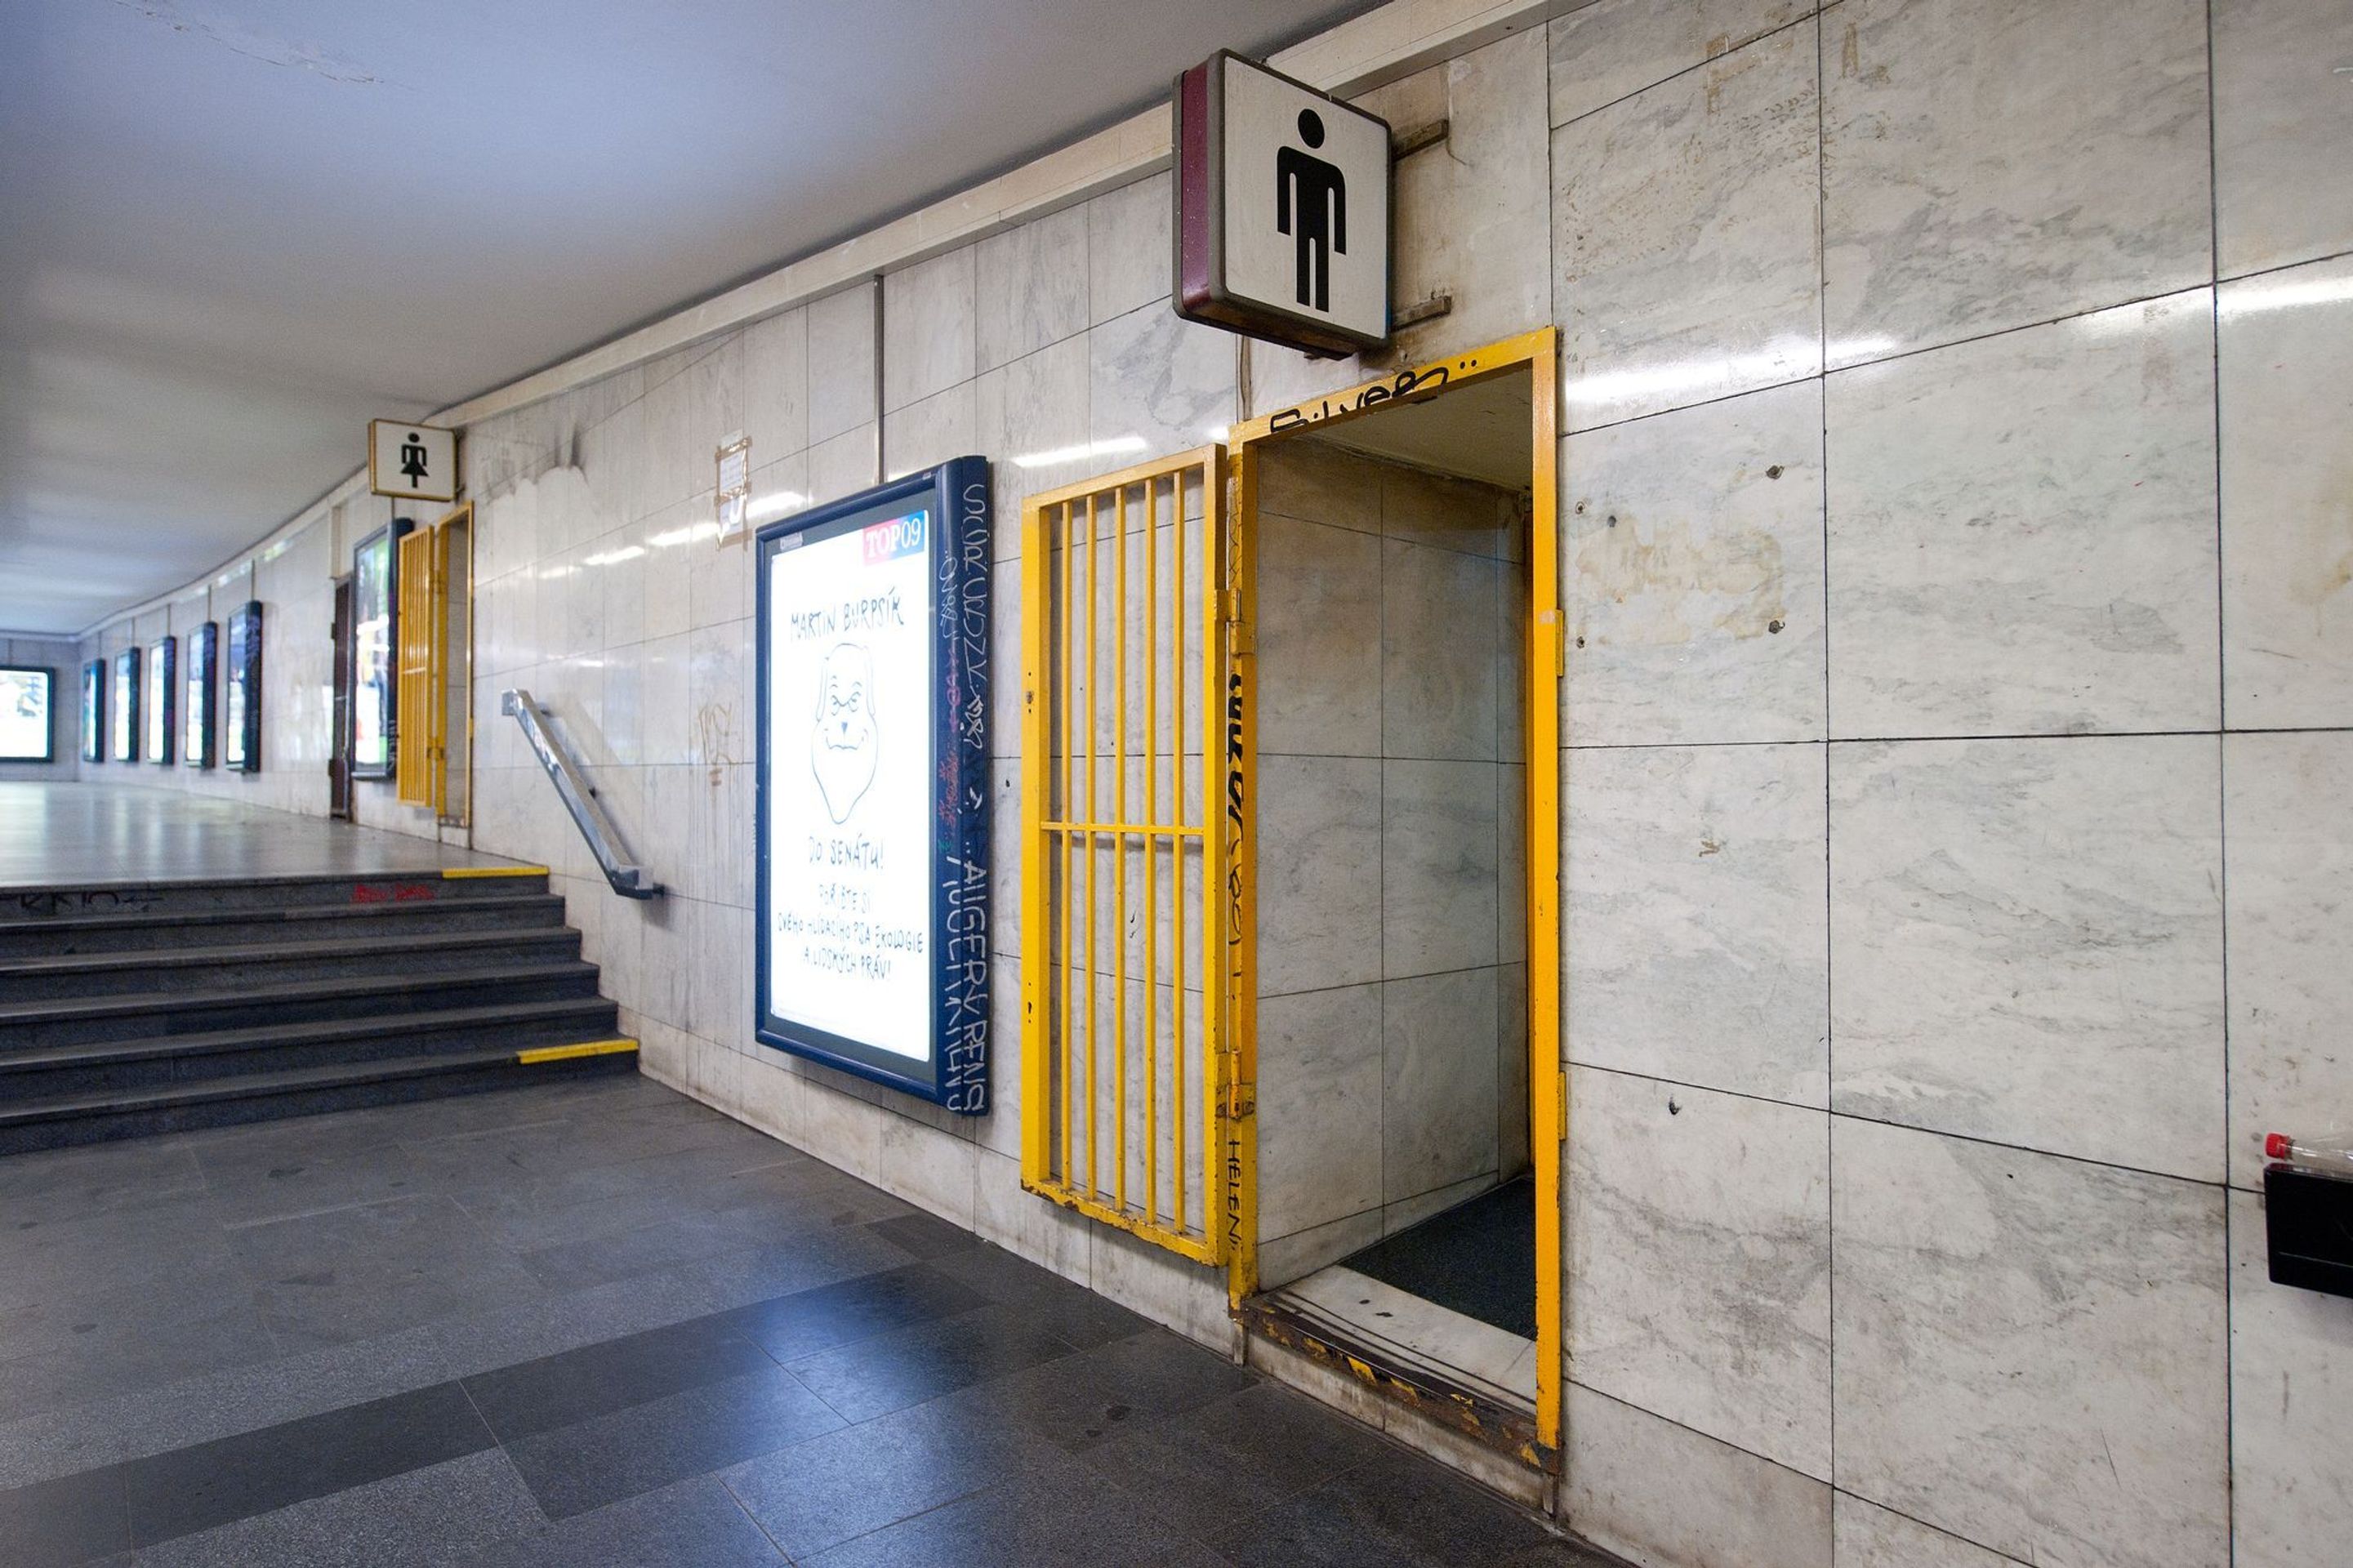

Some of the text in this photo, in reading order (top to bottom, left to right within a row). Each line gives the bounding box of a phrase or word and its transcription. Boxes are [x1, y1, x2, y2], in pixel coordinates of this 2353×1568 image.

[791, 605, 836, 641] MARTIN
[809, 832, 884, 871] DO SENÁTU!
